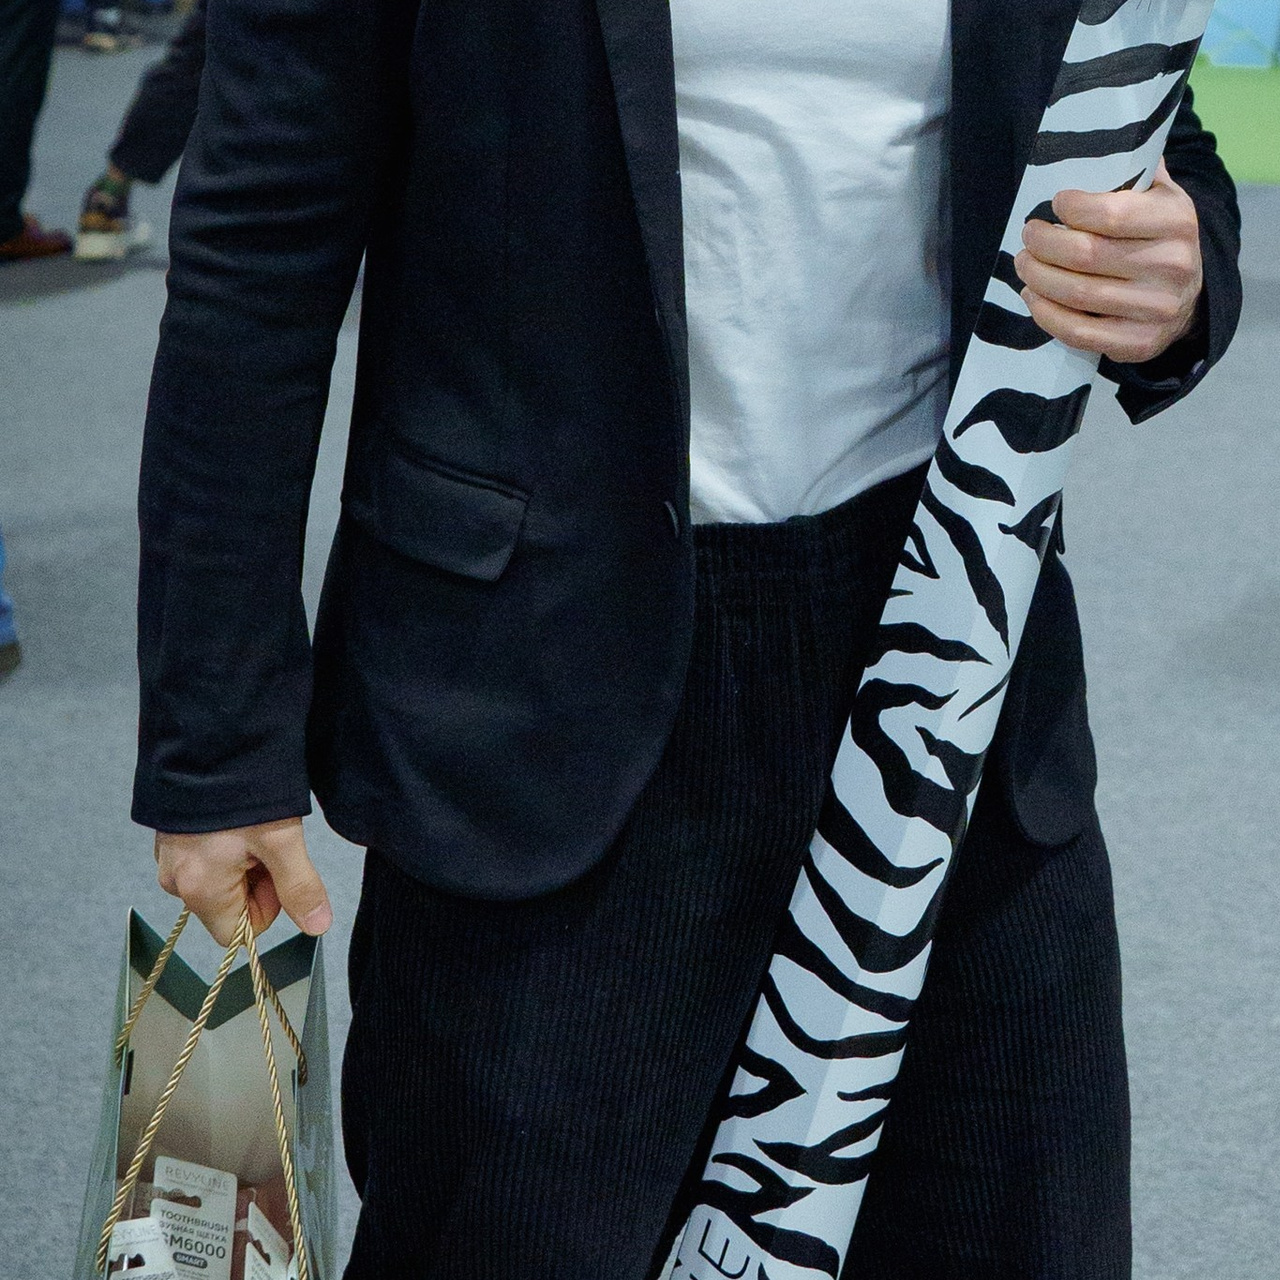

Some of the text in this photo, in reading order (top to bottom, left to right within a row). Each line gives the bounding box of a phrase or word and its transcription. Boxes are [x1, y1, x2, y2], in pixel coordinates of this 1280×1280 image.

[164, 1165, 231, 1192] REVYLINE
[159, 1220, 195, 1235] ЗУБНАЯ
[160, 1210, 229, 1234] TOOTHBRUSH
